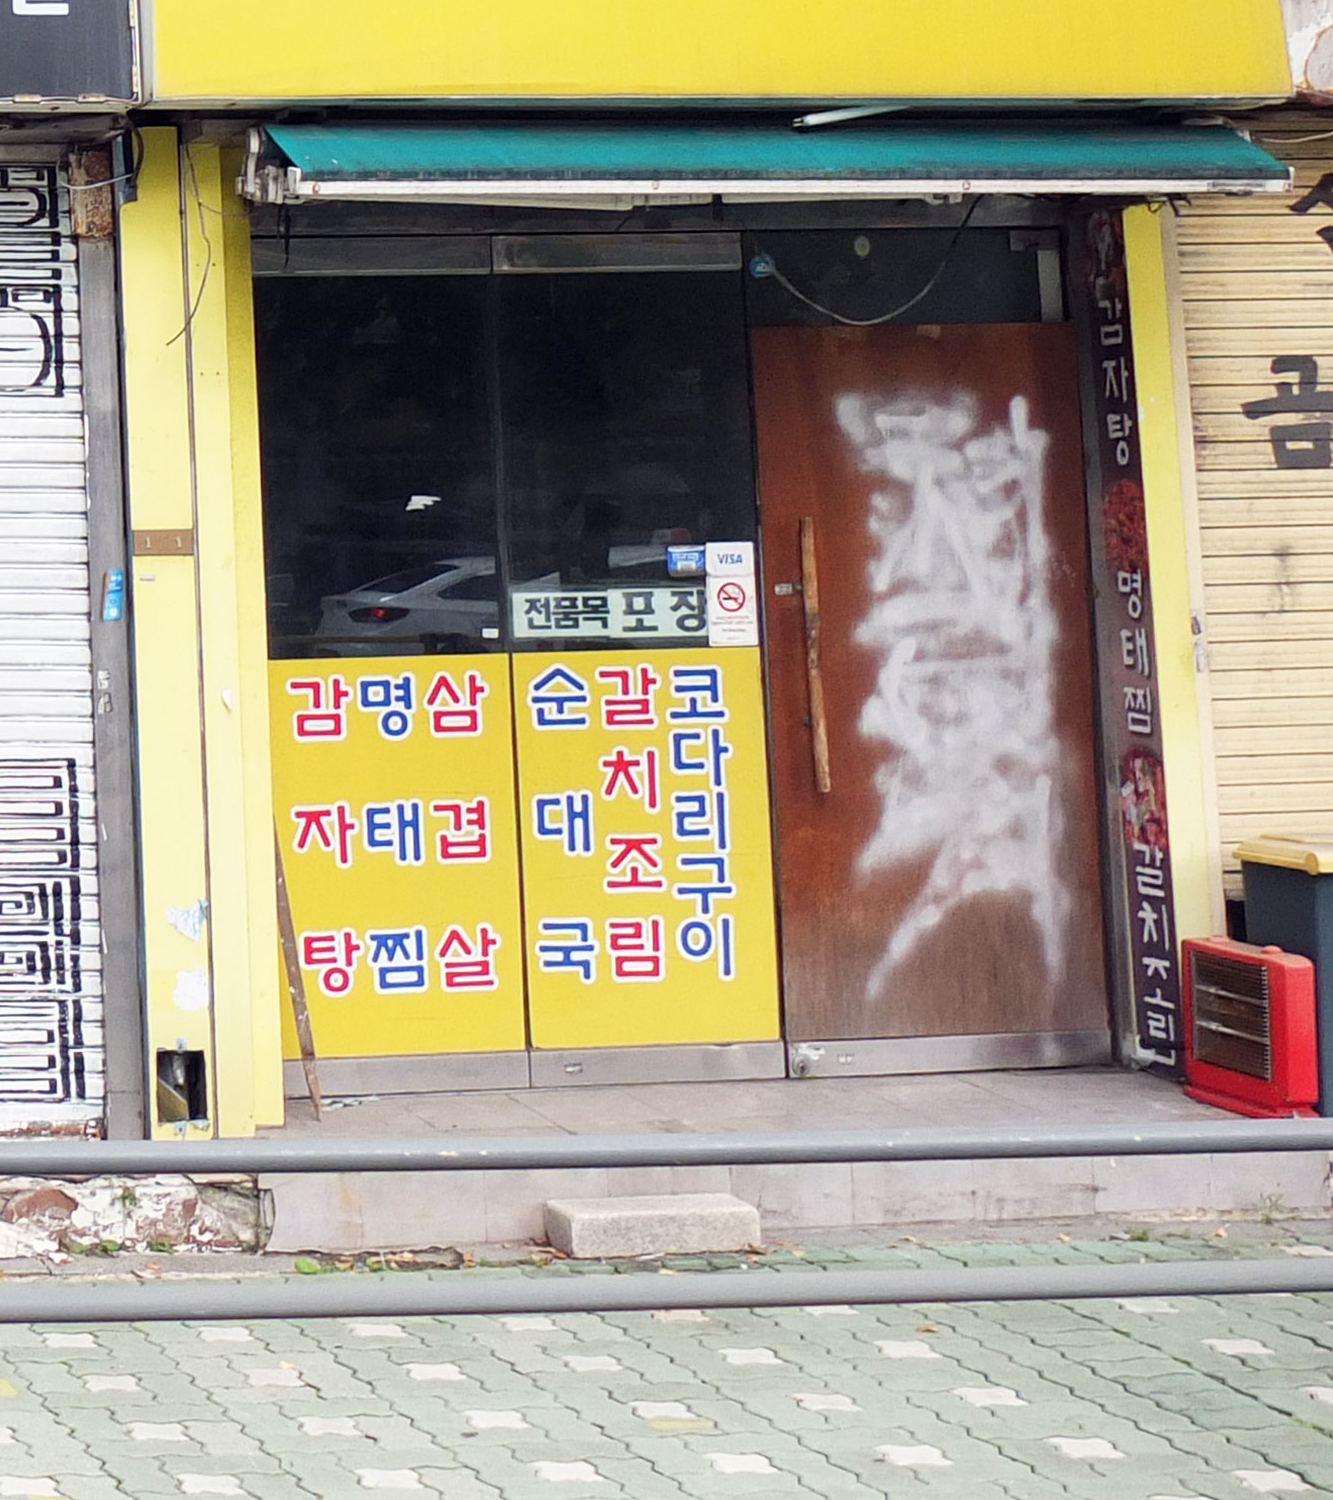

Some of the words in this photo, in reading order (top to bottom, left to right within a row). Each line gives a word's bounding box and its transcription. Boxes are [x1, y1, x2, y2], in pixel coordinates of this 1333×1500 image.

[1097, 298, 1133, 466] 감자탕
[523, 595, 611, 630] 전품목
[716, 553, 744, 565] VISA
[1117, 567, 1153, 735] 명태찜
[598, 667, 663, 978] 갈치조림
[669, 668, 733, 977] 코다리구이
